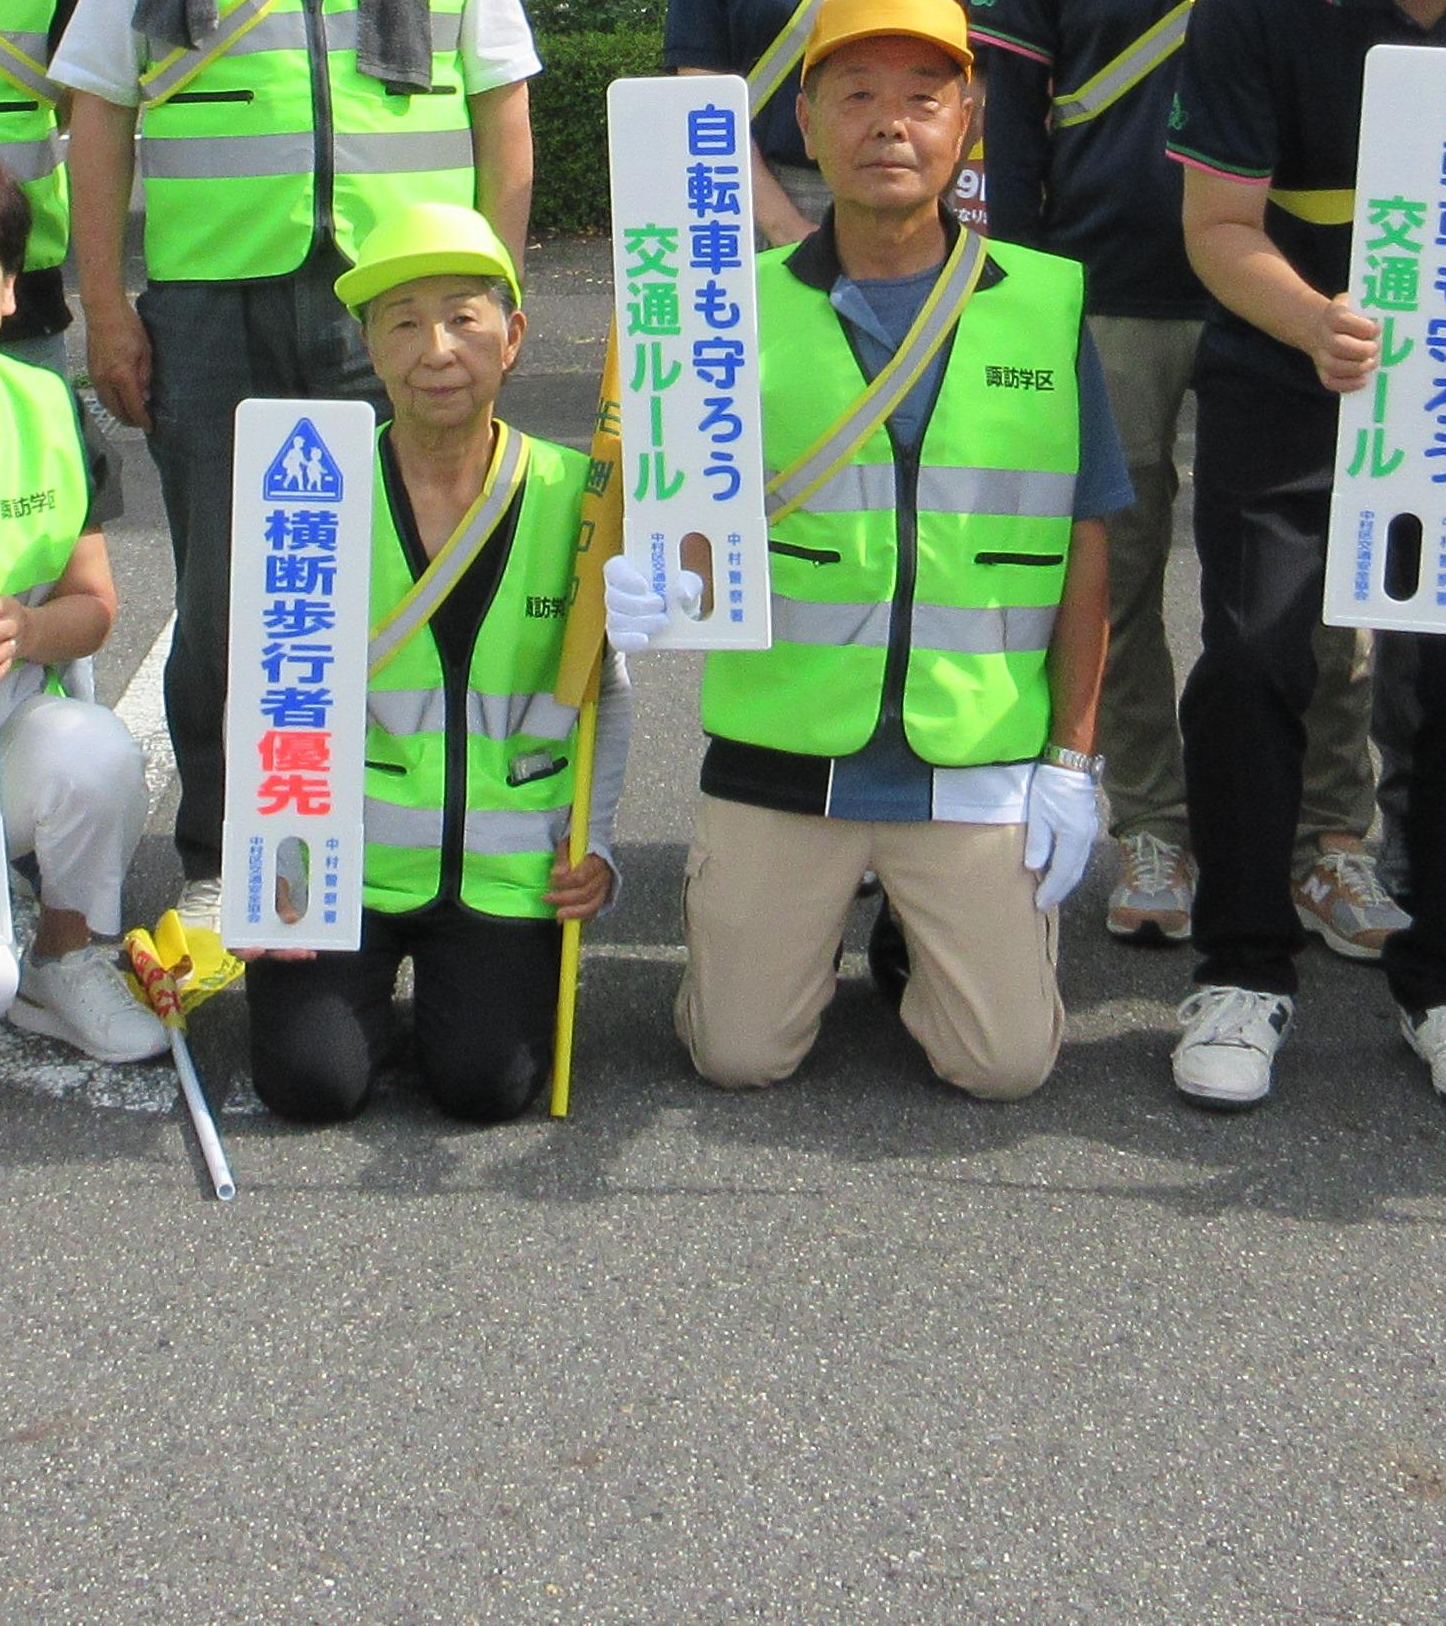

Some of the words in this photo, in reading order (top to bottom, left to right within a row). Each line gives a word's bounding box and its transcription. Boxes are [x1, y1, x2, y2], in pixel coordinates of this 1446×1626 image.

[624, 224, 686, 501] 交通ルール
[686, 103, 746, 503] 自転車も守ろう
[985, 366, 1054, 391] 諏訪学区
[257, 509, 339, 817] 横断歩行者優先
